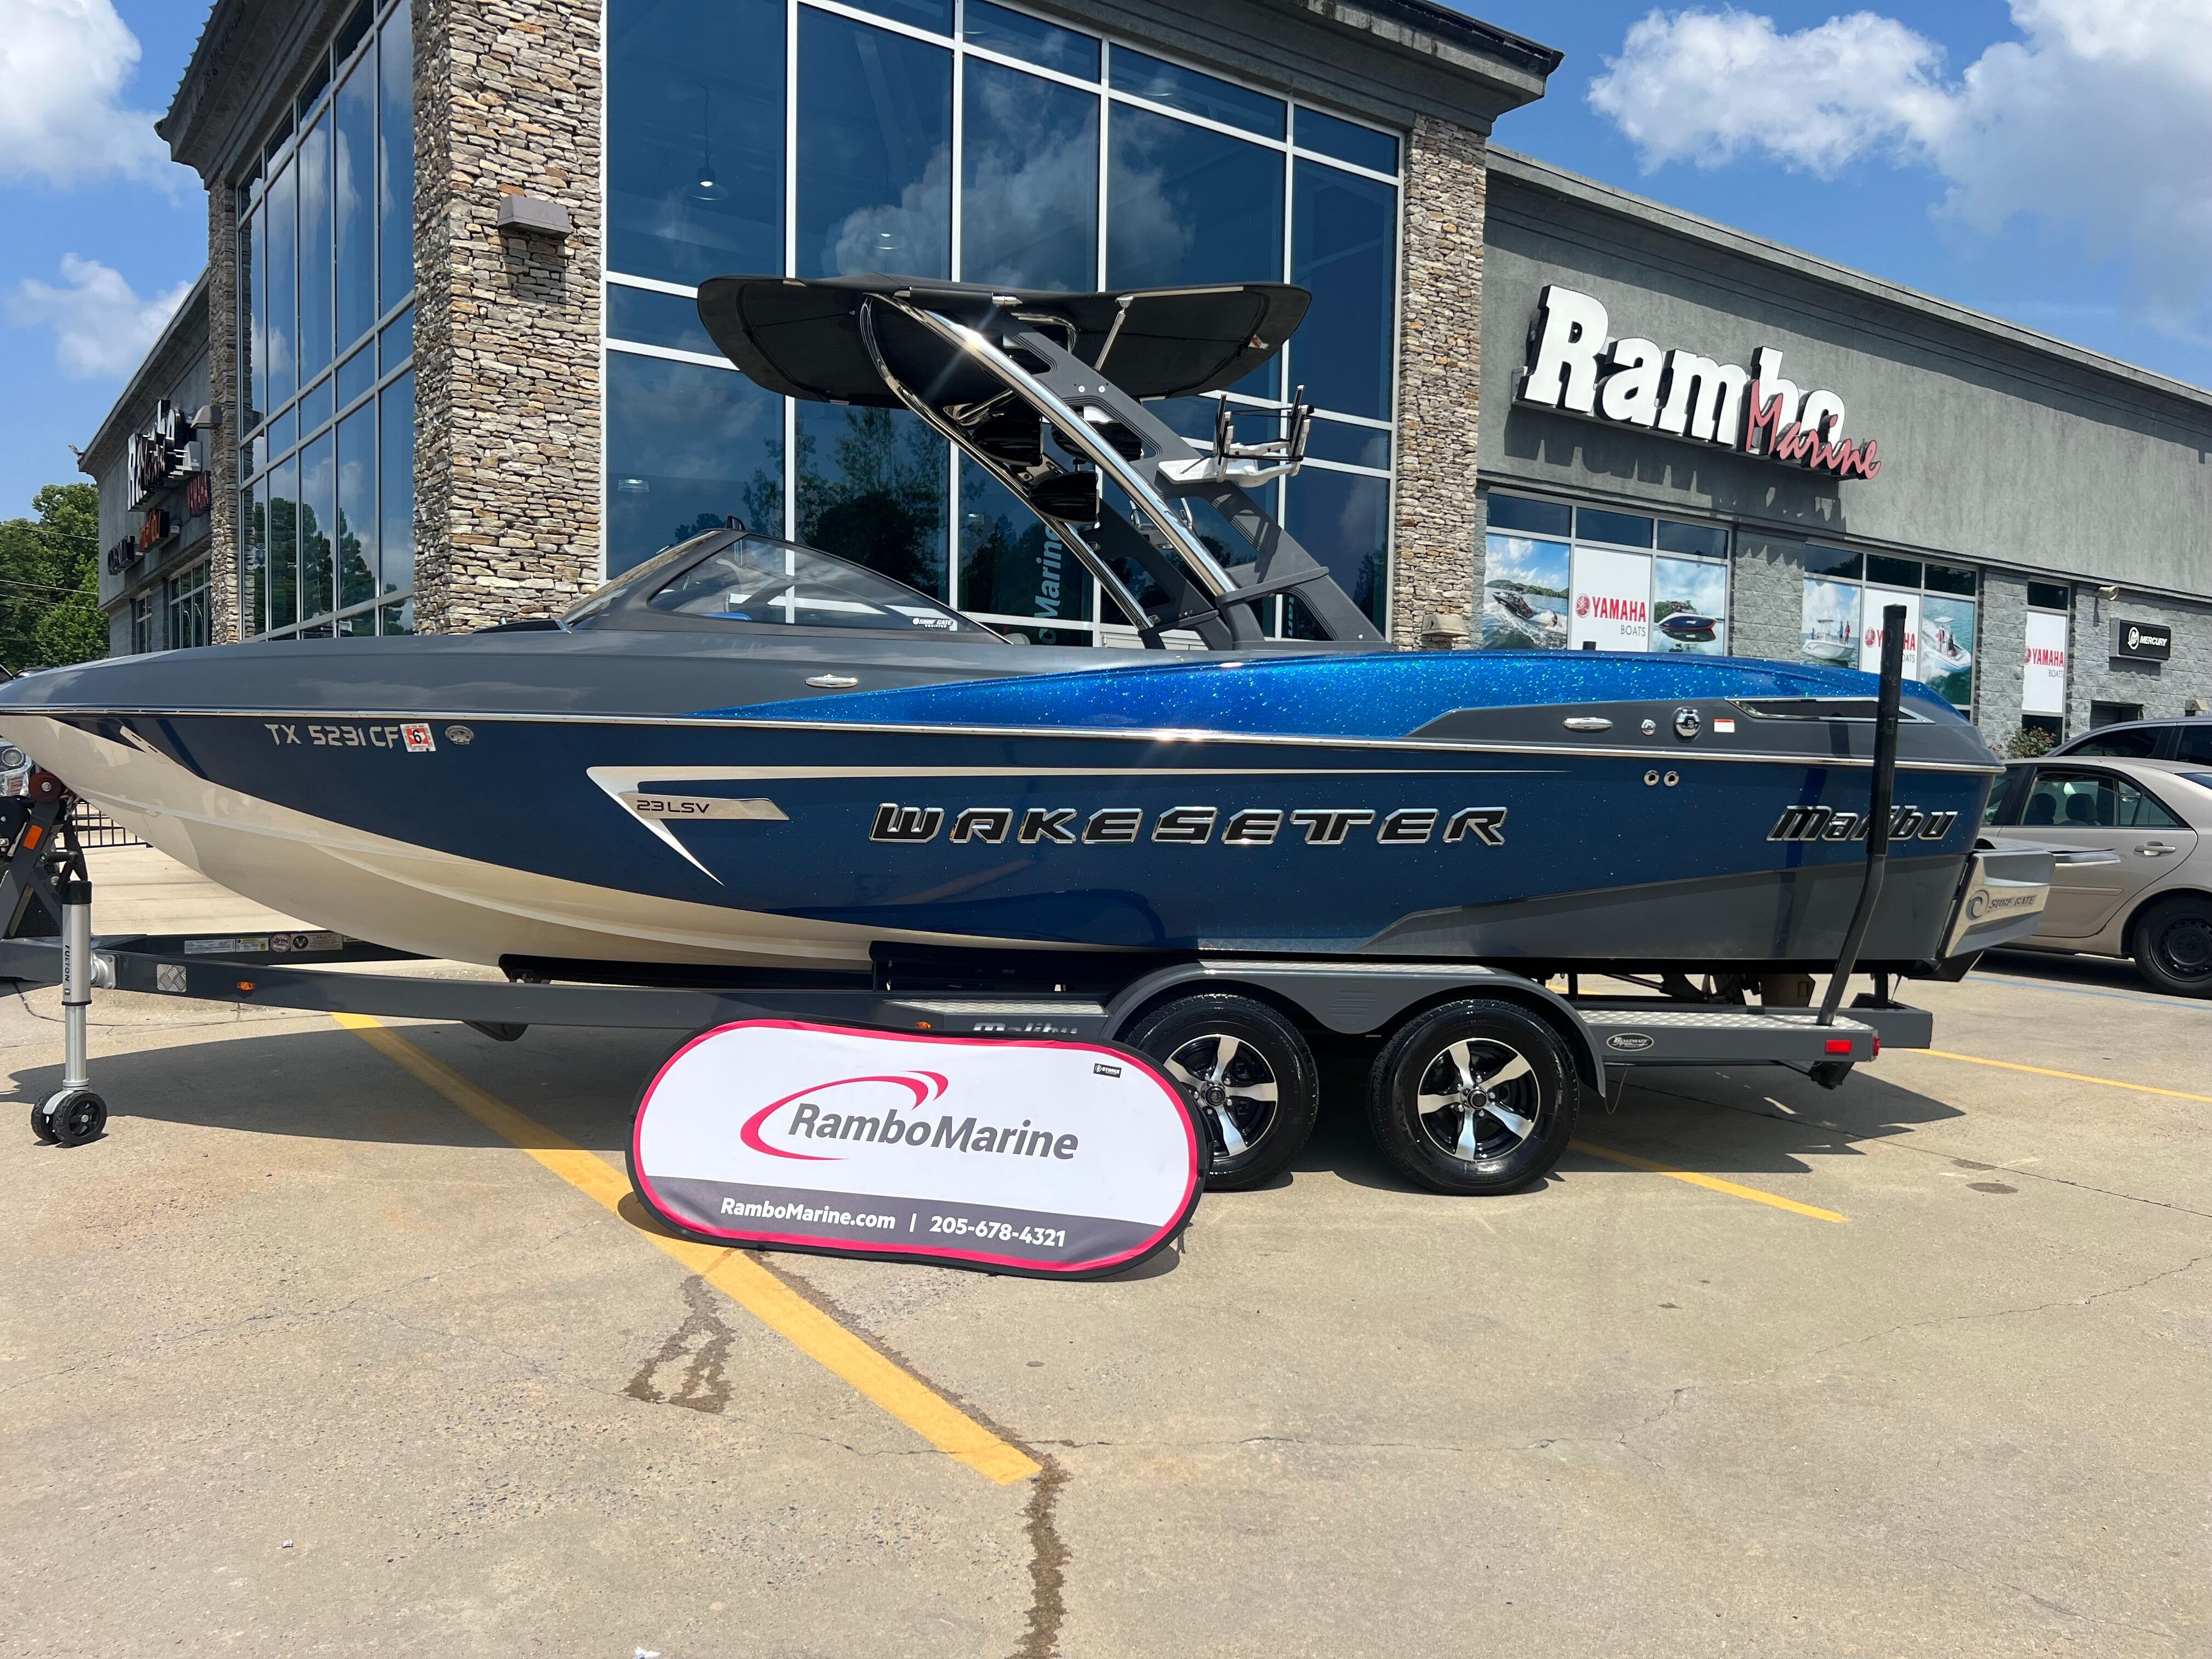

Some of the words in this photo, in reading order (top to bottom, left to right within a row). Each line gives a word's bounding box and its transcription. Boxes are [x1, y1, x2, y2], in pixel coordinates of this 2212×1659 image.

[1520, 284, 1846, 455] Rambo
[1745, 380, 1882, 479] Marine
[1592, 596, 1646, 622] YAMAHA
[1620, 625, 1646, 636] BOATS
[1877, 629, 1915, 651] YHA
[2140, 635, 2168, 647] MERCURY
[2032, 648, 2064, 667] YAMAHA
[2048, 669, 2063, 678] BOATS
[264, 724, 302, 746] TX
[413, 730, 422, 744] 6
[1766, 805, 1959, 841] Malbu
[1989, 898, 2013, 909] SURF
[2013, 895, 2036, 906] GATE
[788, 1103, 1079, 1160] RamboMarine
[720, 1197, 896, 1229] RamboMarine.com
[929, 1216, 1066, 1248] 205-678-4321
